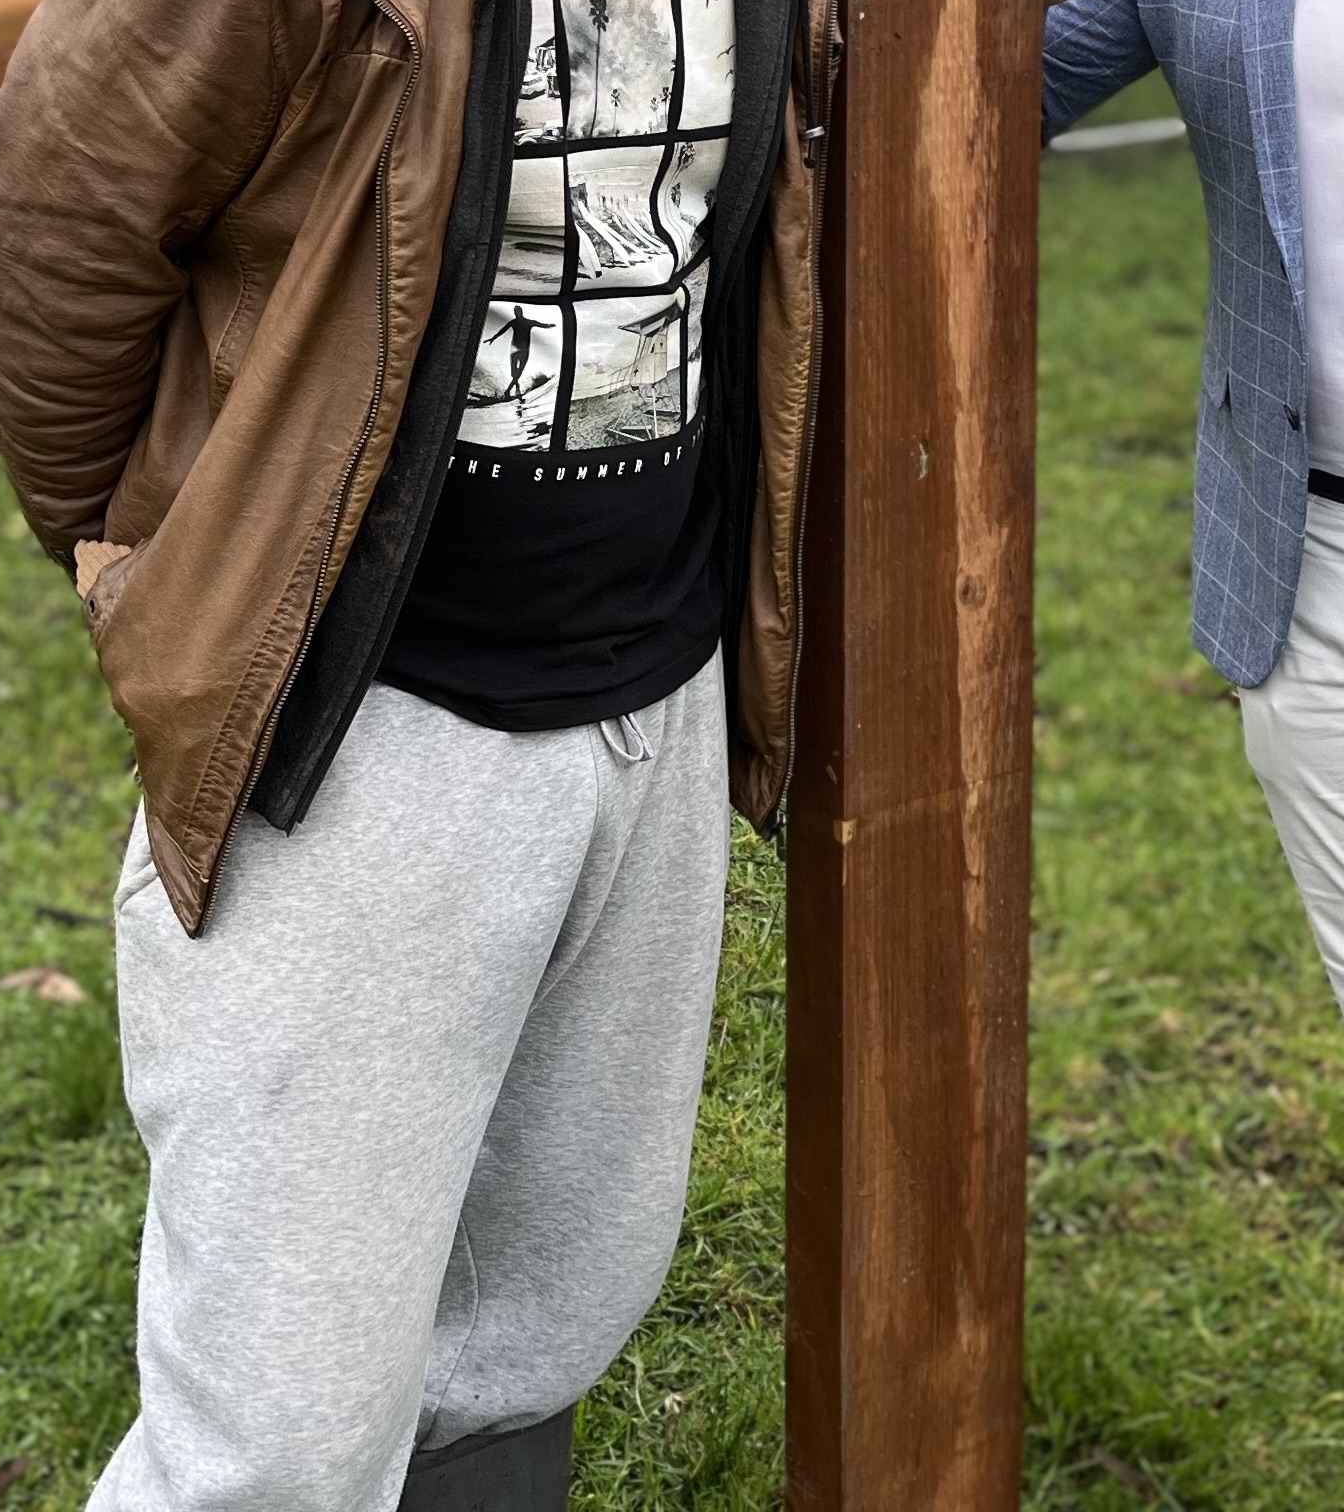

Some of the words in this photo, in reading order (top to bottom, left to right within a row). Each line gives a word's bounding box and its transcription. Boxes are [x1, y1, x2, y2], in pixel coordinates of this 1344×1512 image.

[447, 455, 502, 478] THE
[533, 459, 644, 482] SUMMER
[663, 445, 683, 466] OF
